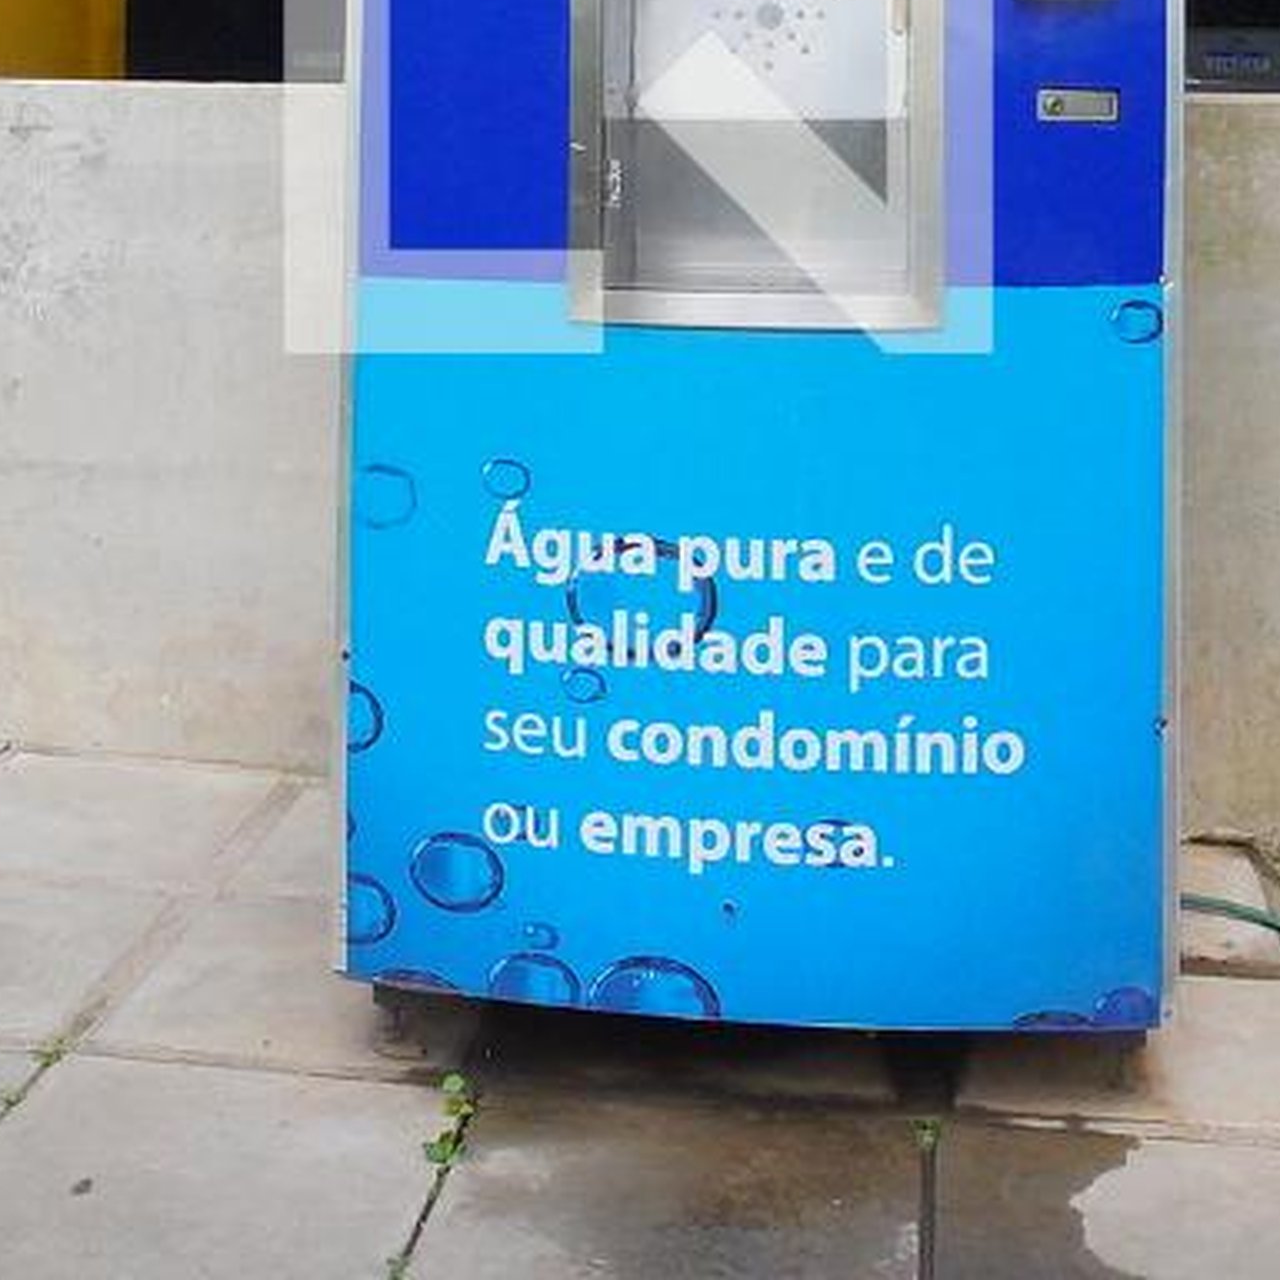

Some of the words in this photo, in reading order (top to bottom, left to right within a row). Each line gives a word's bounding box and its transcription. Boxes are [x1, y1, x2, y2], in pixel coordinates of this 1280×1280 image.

[484, 500, 658, 585] Água
[676, 532, 837, 593] pura
[856, 539, 895, 584] e
[913, 523, 996, 585] de
[483, 609, 829, 675] qualidade
[848, 632, 989, 693] para
[483, 708, 586, 758] seu
[607, 709, 1027, 775] condomínio
[482, 801, 559, 848] ou
[579, 809, 896, 874] empresa.
